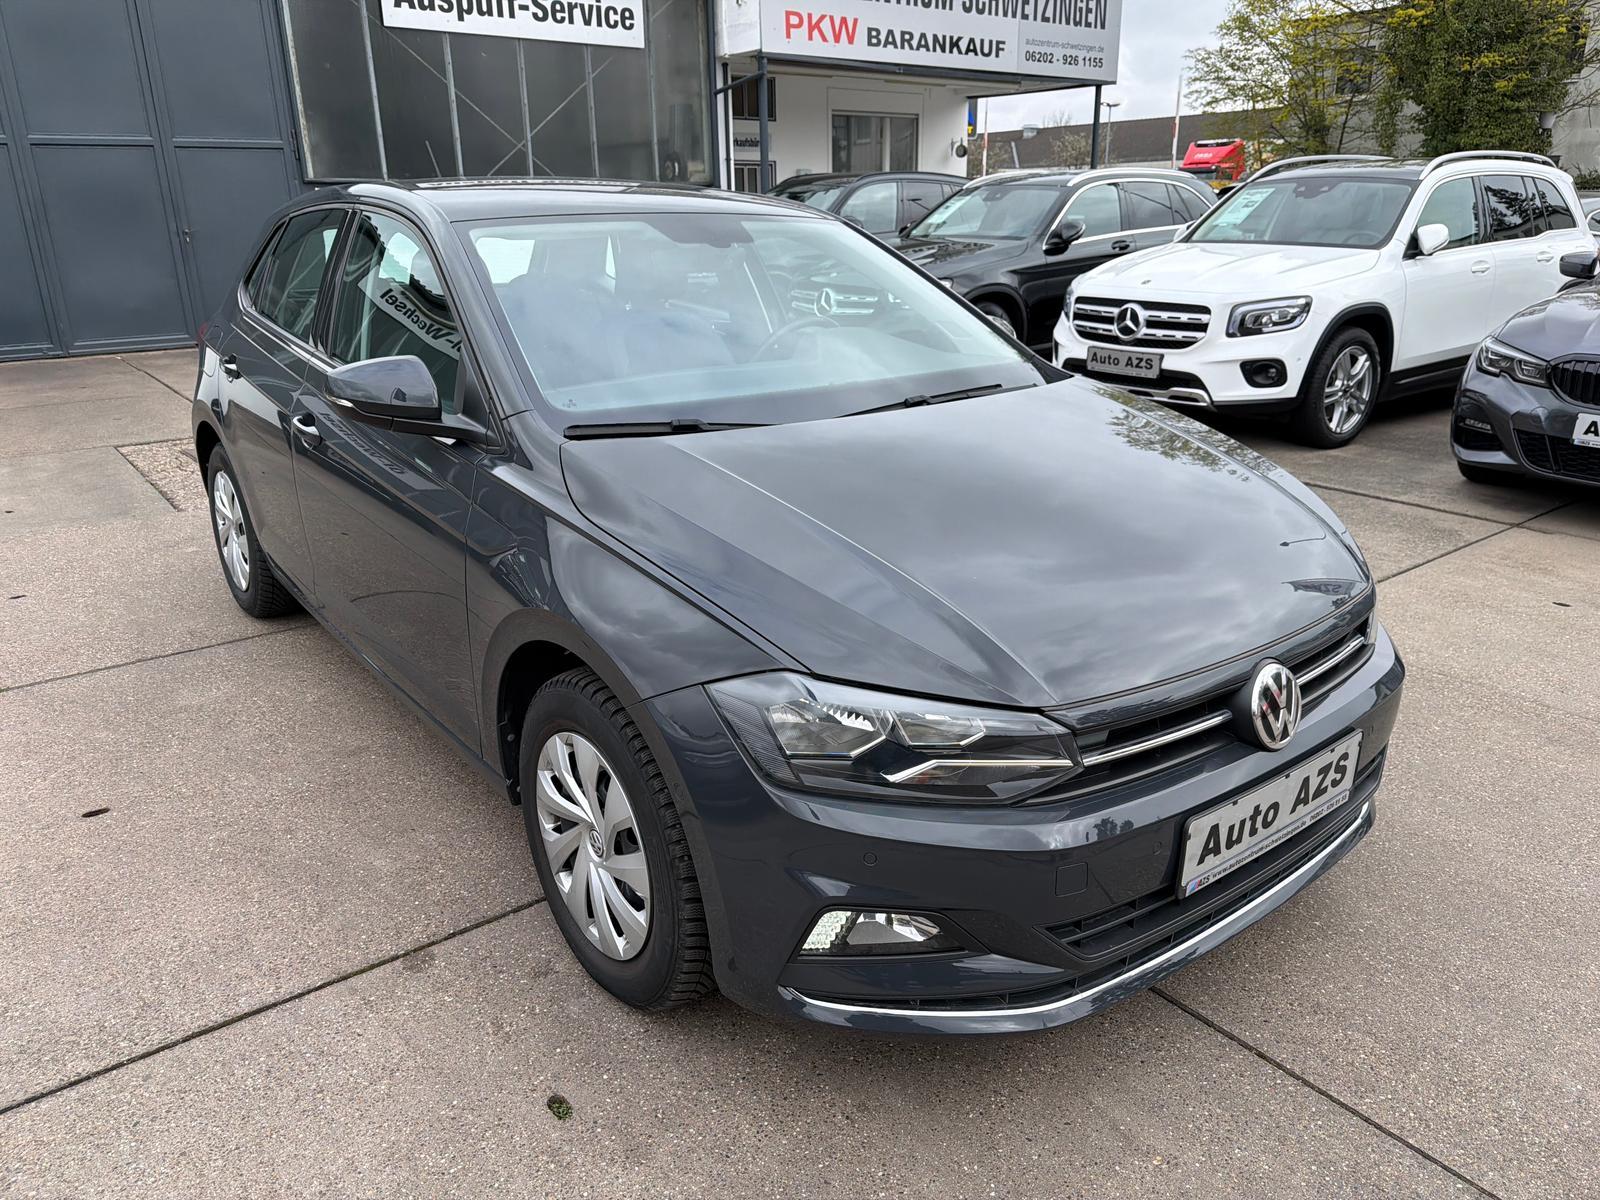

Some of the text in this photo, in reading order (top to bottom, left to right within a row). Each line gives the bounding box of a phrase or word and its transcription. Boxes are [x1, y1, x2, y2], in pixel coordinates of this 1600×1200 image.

[394, 0, 635, 31] puff-Service
[785, 10, 1006, 59] PKW BARANKAUF
[1025, 51, 1055, 64] 06202
[1062, 54, 1079, 66] 926
[1082, 56, 1103, 68] 1155
[1091, 352, 1154, 370] Auto AZS
[1196, 751, 1350, 867] Auto AZS
